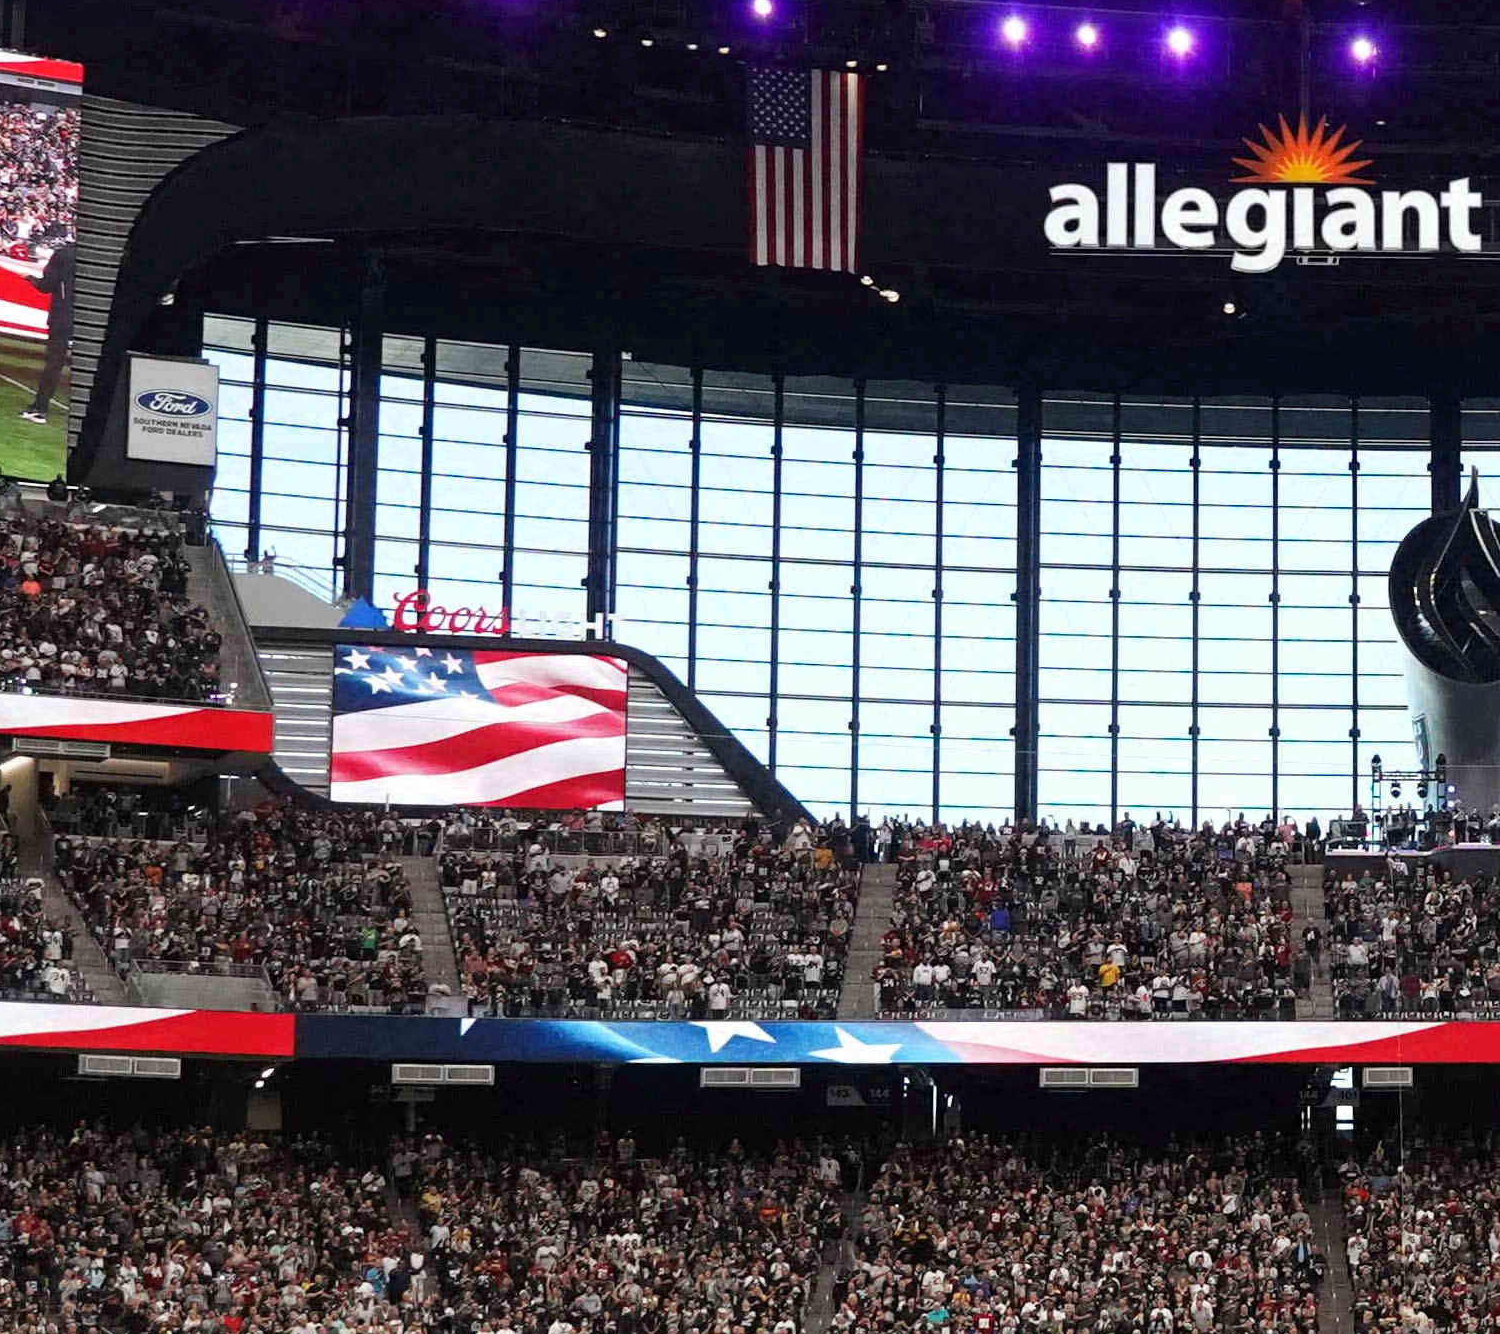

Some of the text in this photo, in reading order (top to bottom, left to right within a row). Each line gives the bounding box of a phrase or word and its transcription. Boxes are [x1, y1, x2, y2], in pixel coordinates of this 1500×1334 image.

[1043, 161, 1483, 273] allegiant
[150, 392, 197, 415] Ford
[133, 417, 212, 431] SOUTHERN NEVADA
[142, 426, 204, 438] FORD DEALERS
[392, 589, 511, 635] Coors
